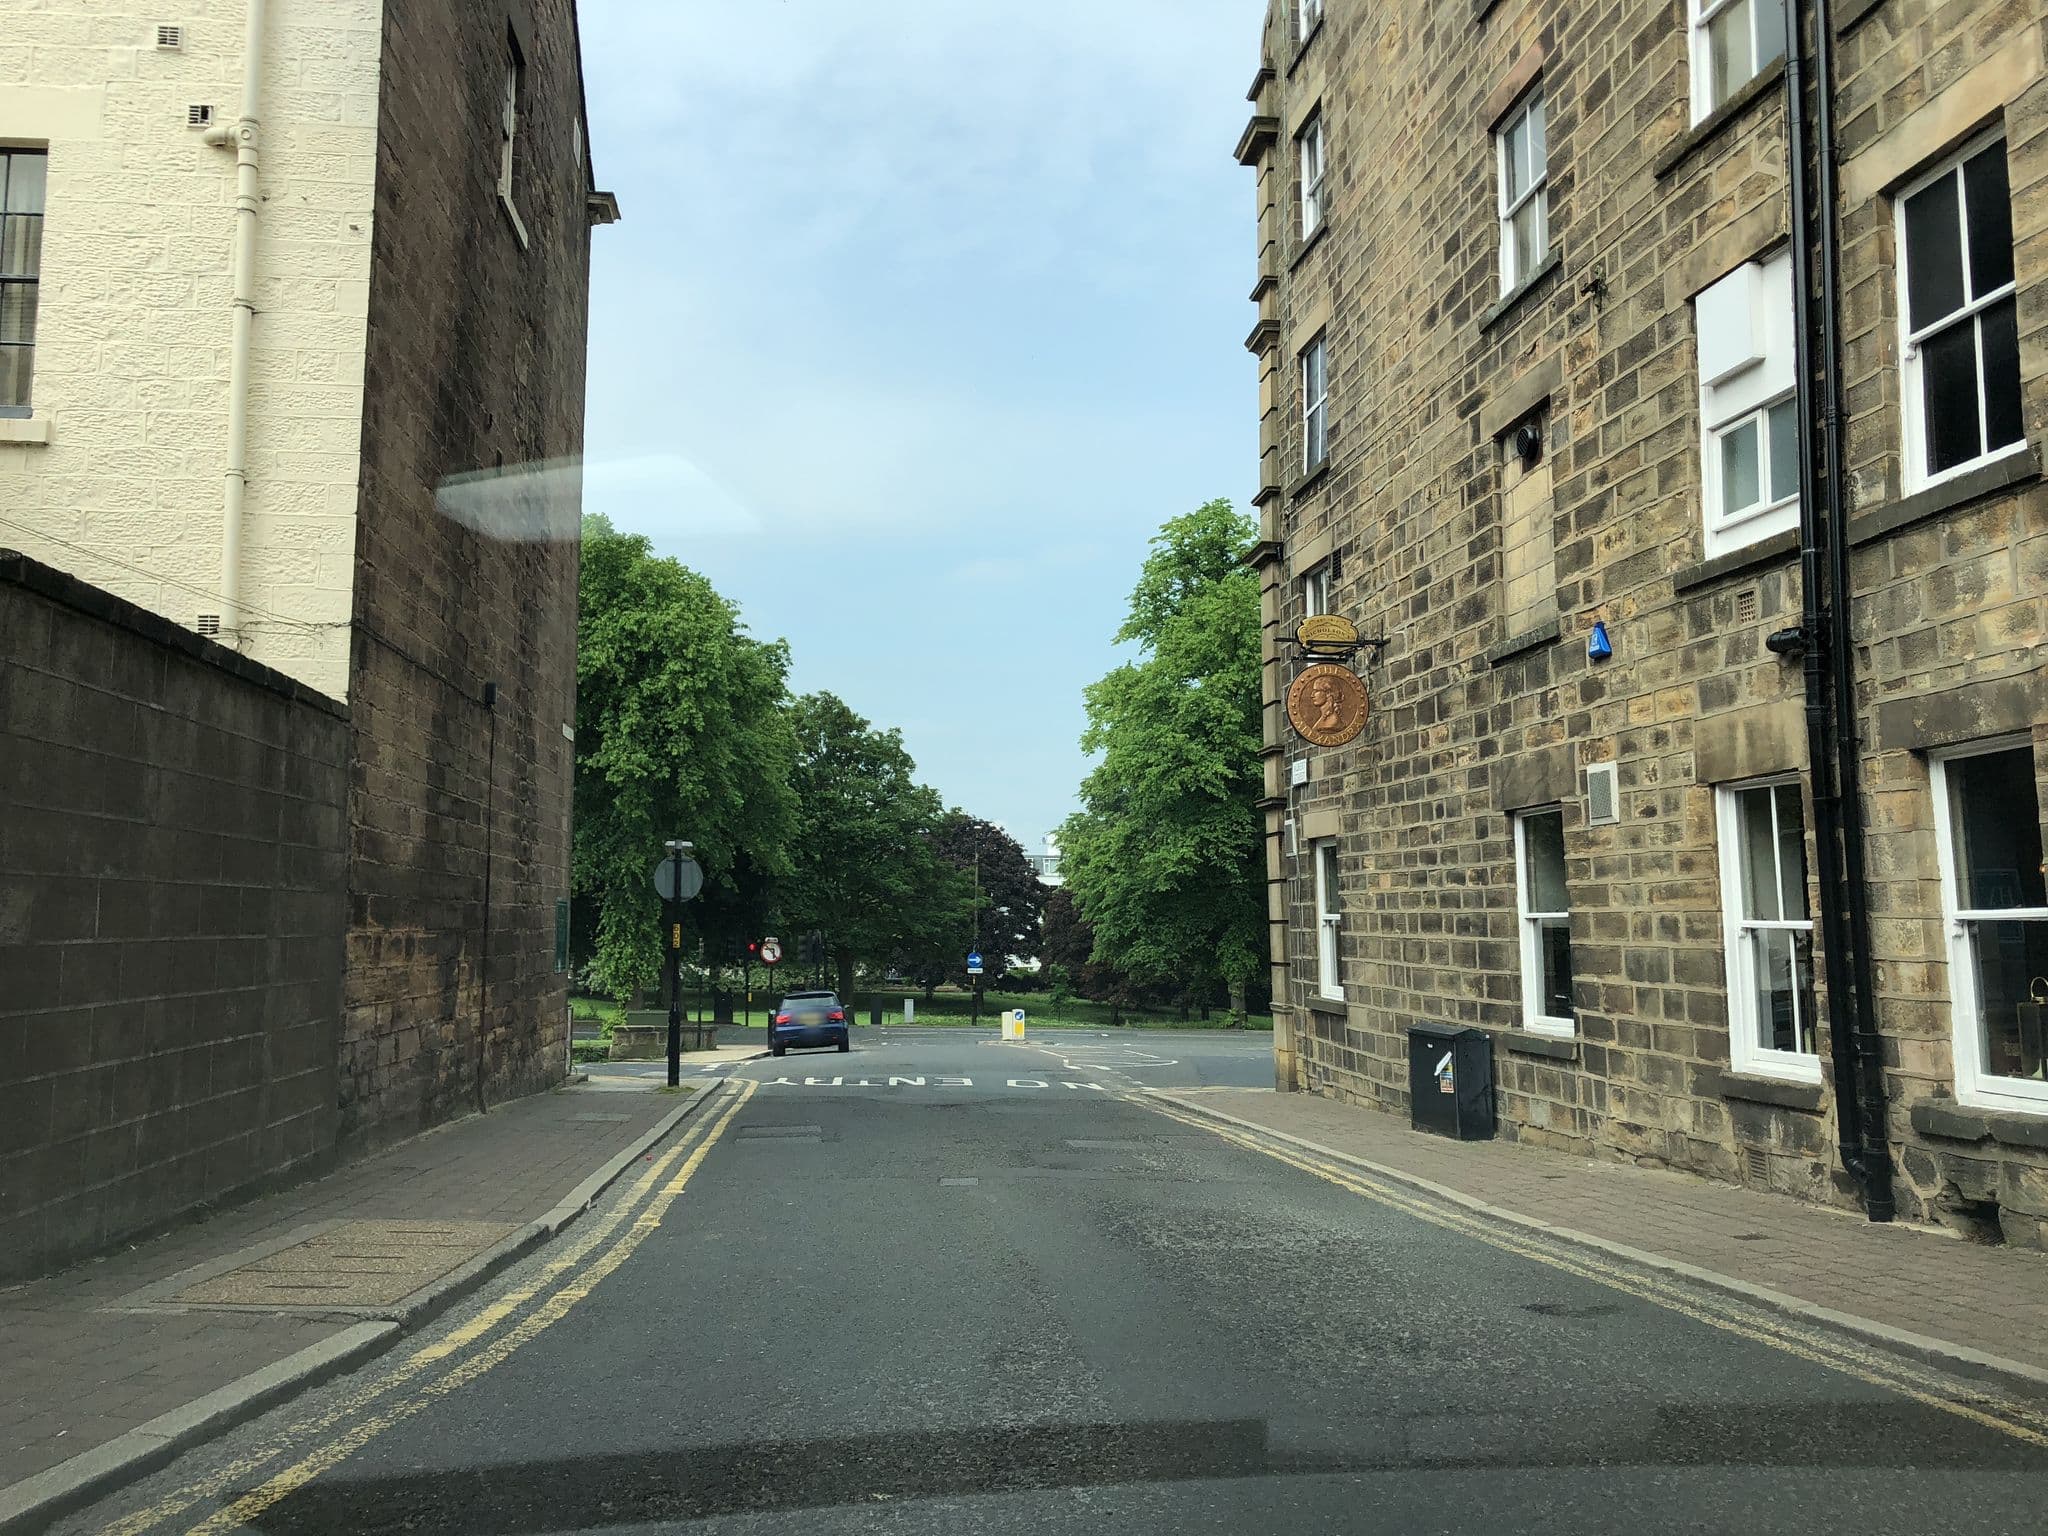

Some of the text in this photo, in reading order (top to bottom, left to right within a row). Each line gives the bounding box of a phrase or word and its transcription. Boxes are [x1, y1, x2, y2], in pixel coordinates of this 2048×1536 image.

[1313, 666, 1341, 675] THE
[1294, 720, 1363, 745] ALEXANDRA
[760, 1075, 1109, 1091] NO ENTRY
